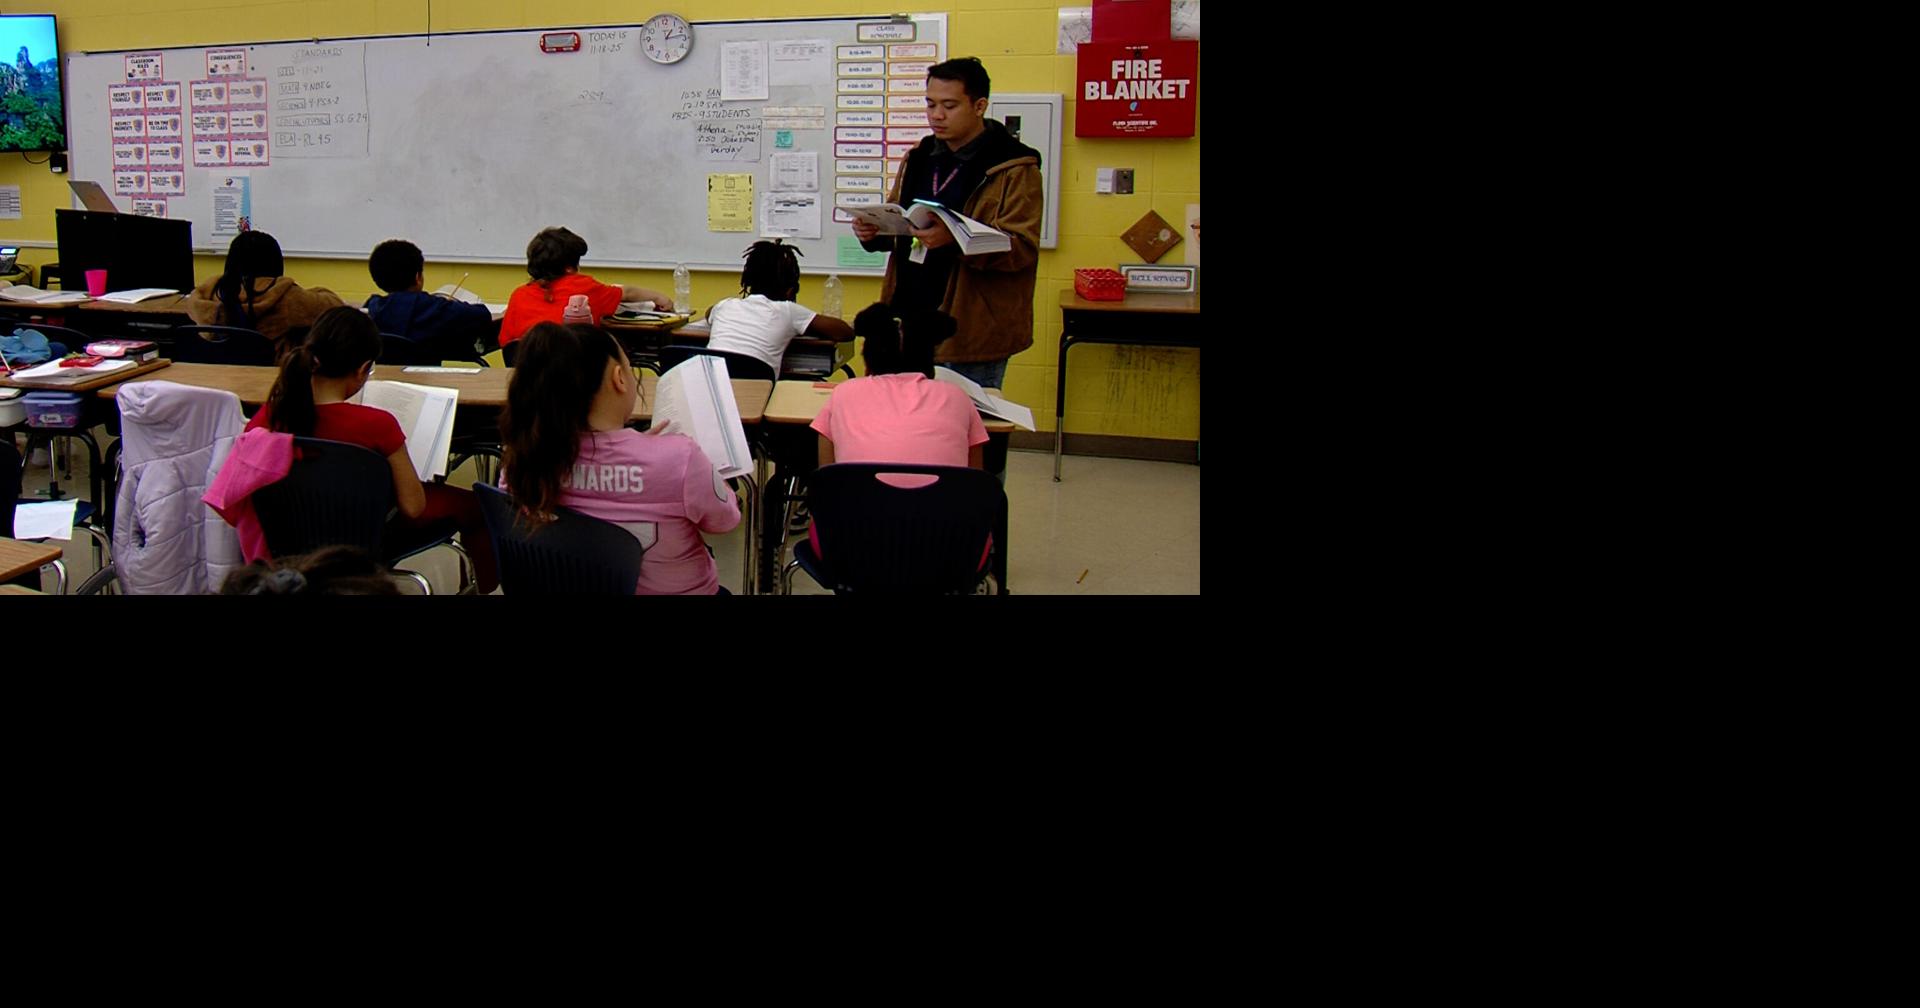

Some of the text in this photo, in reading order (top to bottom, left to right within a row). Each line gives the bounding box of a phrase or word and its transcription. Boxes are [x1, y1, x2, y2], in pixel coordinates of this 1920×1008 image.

[661, 18, 668, 26] 12
[588, 31, 628, 42] TODAY IS
[665, 52, 670, 61] 6
[1111, 59, 1162, 79] FIRE
[1085, 79, 1190, 101] BLANKET
